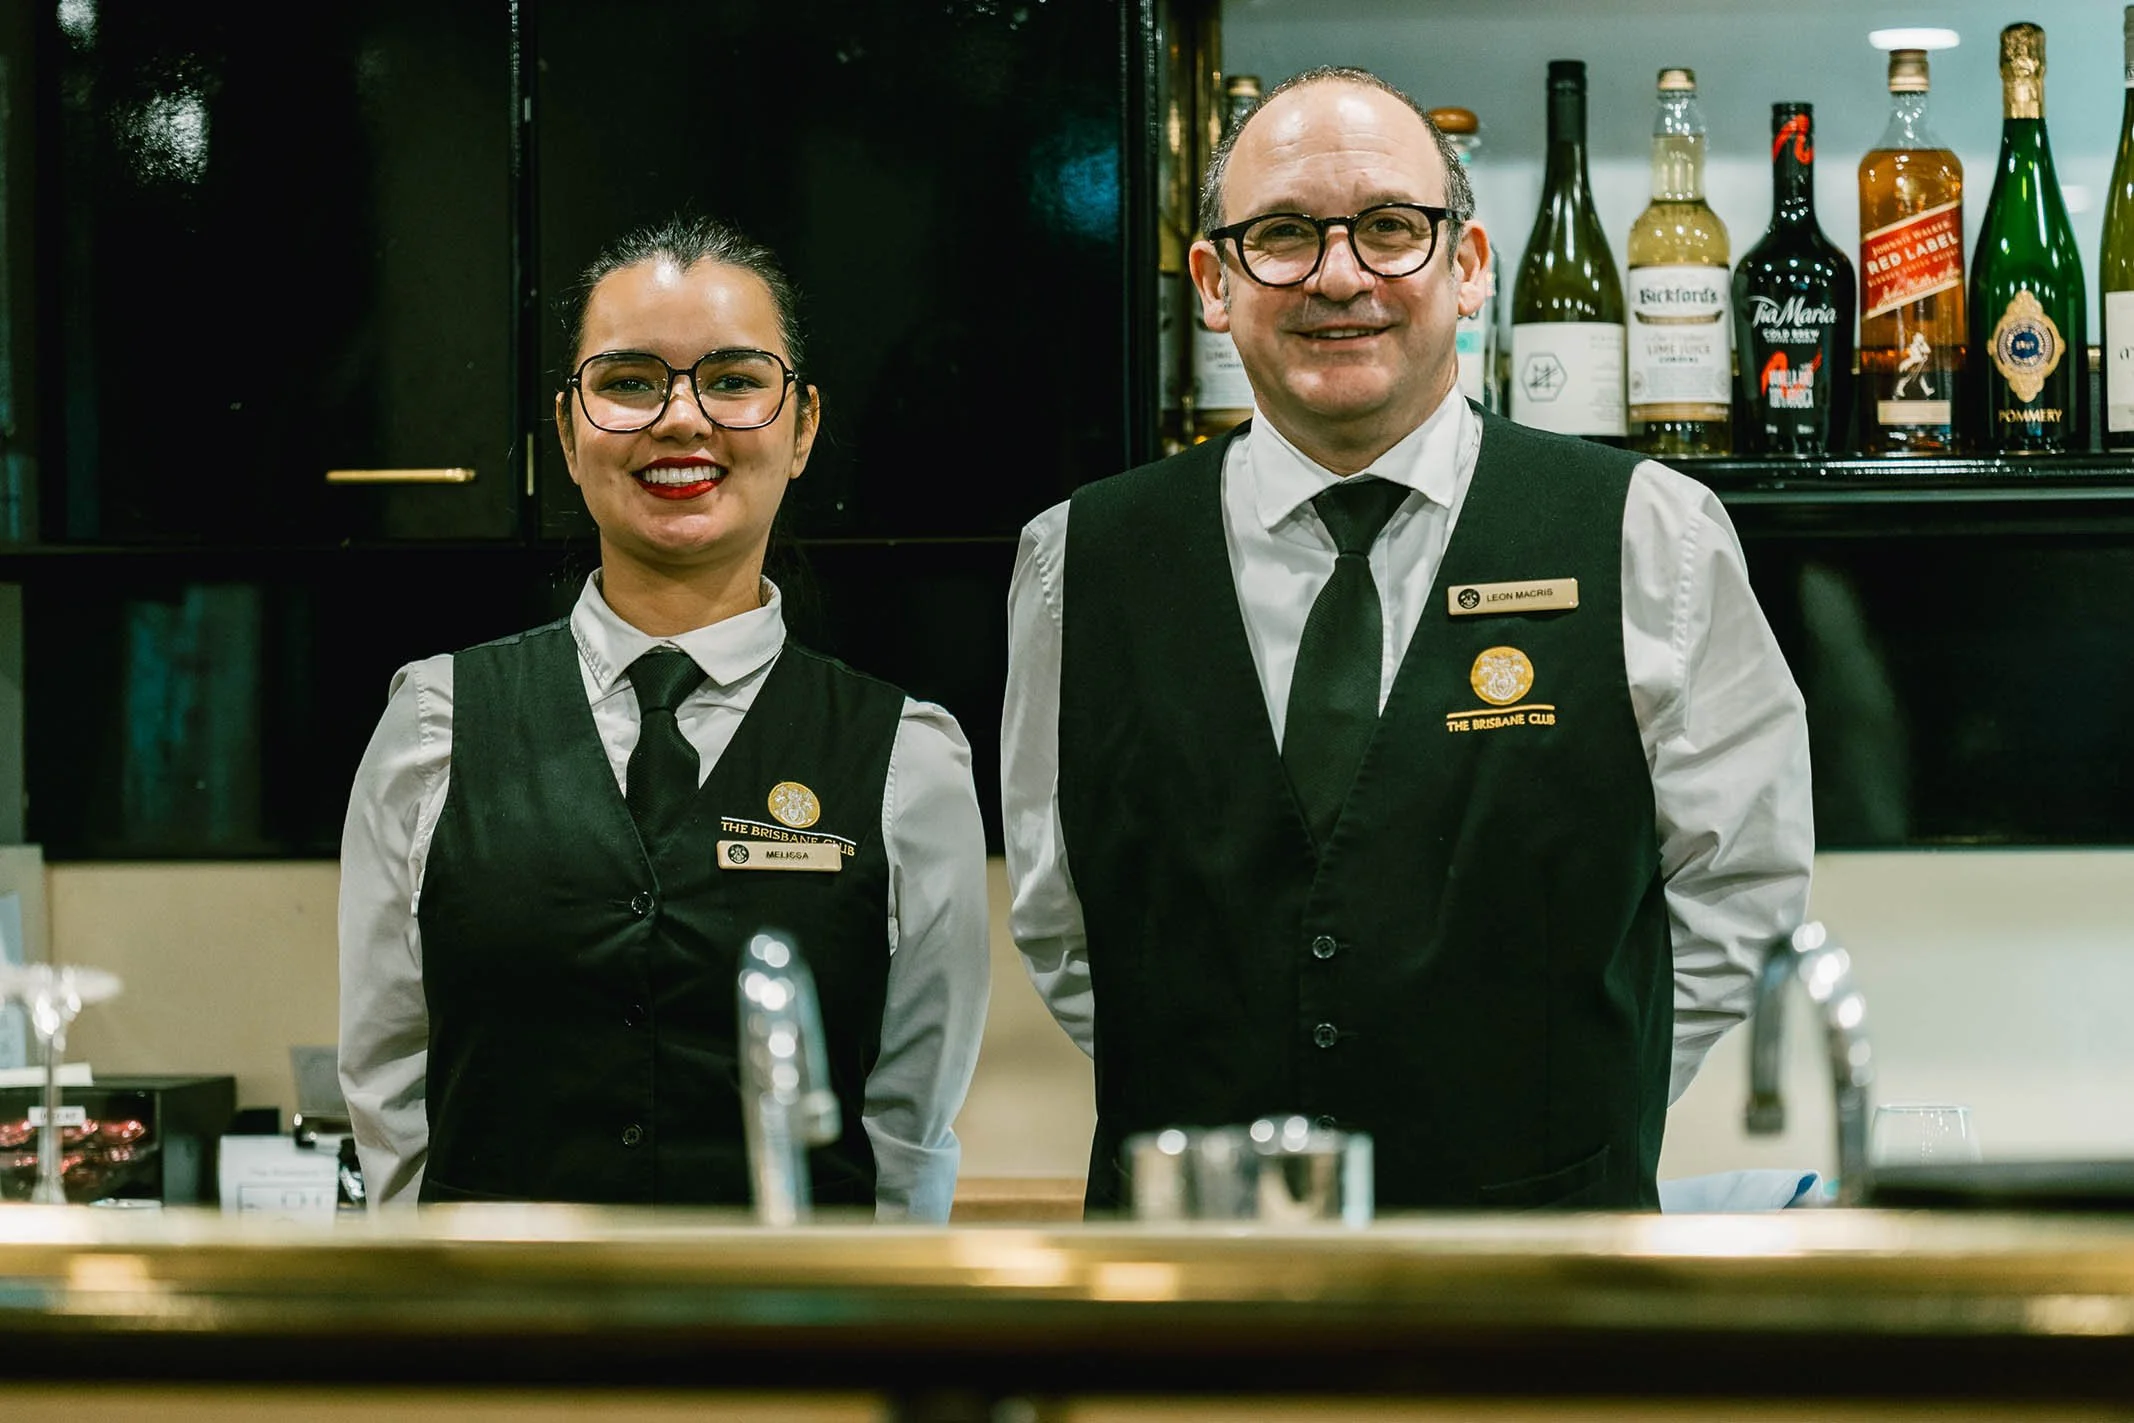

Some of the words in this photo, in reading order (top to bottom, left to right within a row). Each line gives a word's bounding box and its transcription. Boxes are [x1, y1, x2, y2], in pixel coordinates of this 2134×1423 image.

[1866, 252, 1902, 275] RED
[1904, 231, 1958, 260] LABEL
[1749, 295, 1781, 328] Tia
[1776, 296, 1837, 328] Maria
[1762, 328, 1790, 339] COLD
[1791, 328, 1820, 339] BREW
[1998, 408, 2063, 423] POMMERY
[1486, 592, 1513, 602] LEON
[1515, 588, 1553, 600] MACRIS
[1446, 719, 1470, 733] THE
[1472, 714, 1526, 730] BRISBANE
[1528, 712, 1556, 726] CLUB
[720, 821, 748, 834] THE
[751, 825, 818, 844] BRISBANE
[766, 850, 809, 860] MELISSA
